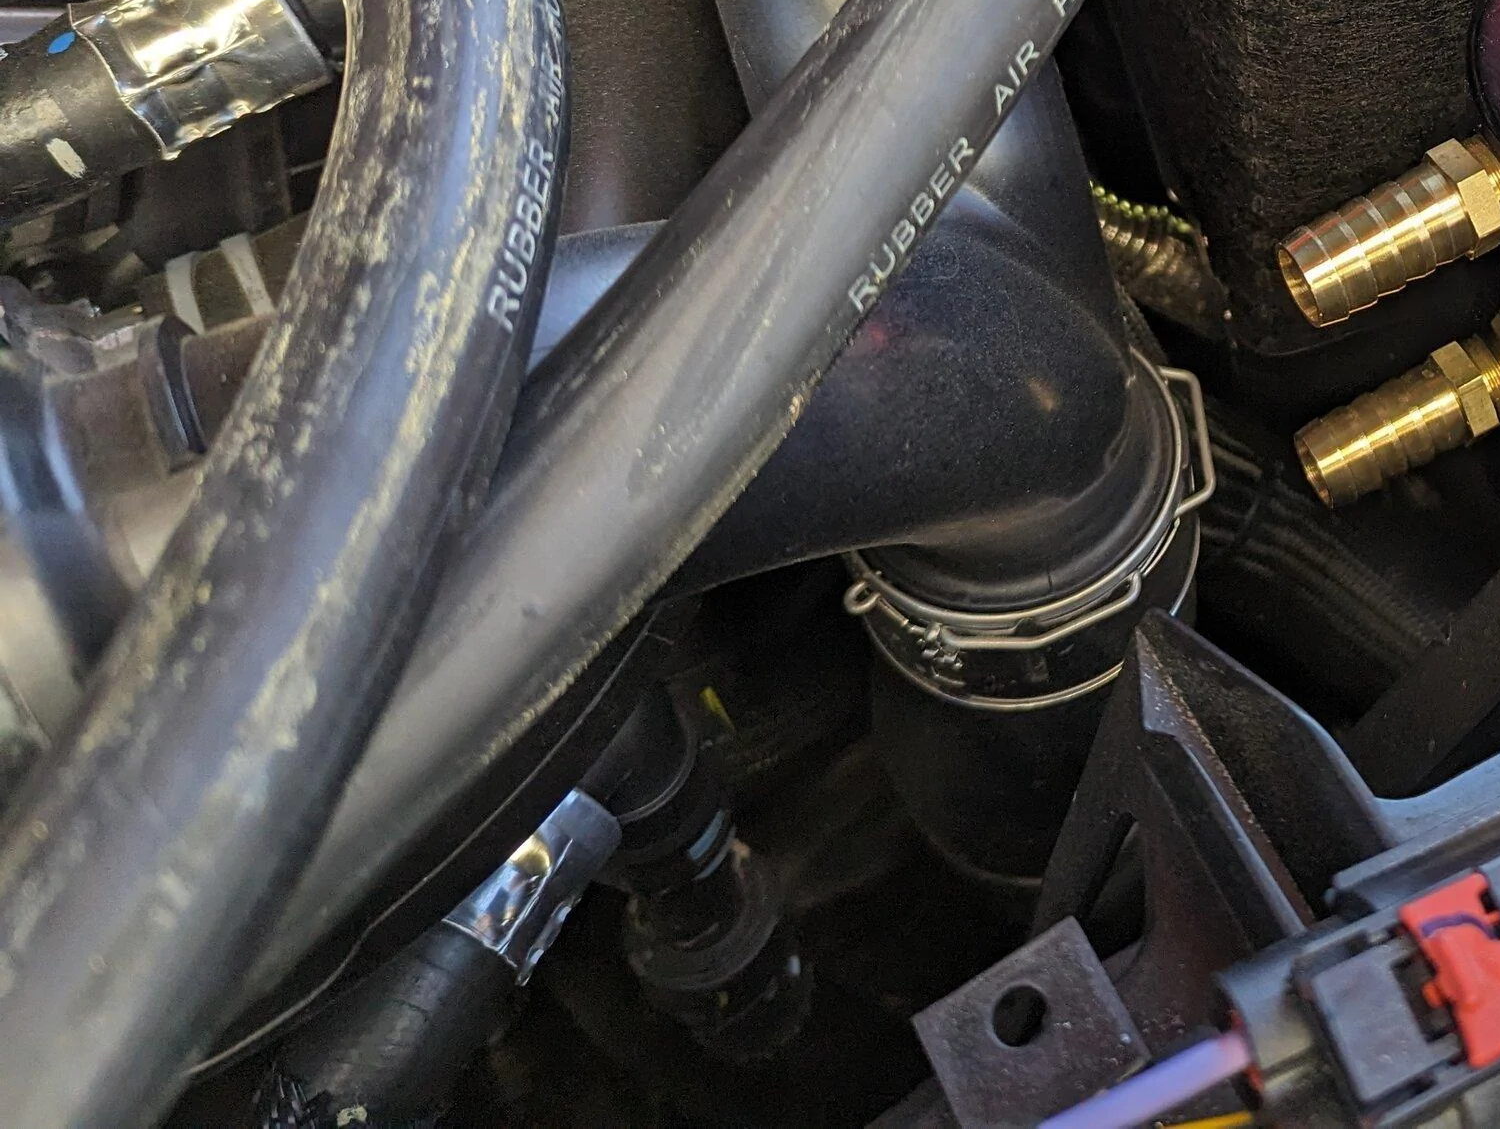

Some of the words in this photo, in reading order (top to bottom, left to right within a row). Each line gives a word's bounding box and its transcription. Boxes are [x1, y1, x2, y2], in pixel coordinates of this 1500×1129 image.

[488, 136, 555, 332] RUBBER
[848, 136, 976, 313] RUBBER
[992, 39, 1041, 118] AIR
